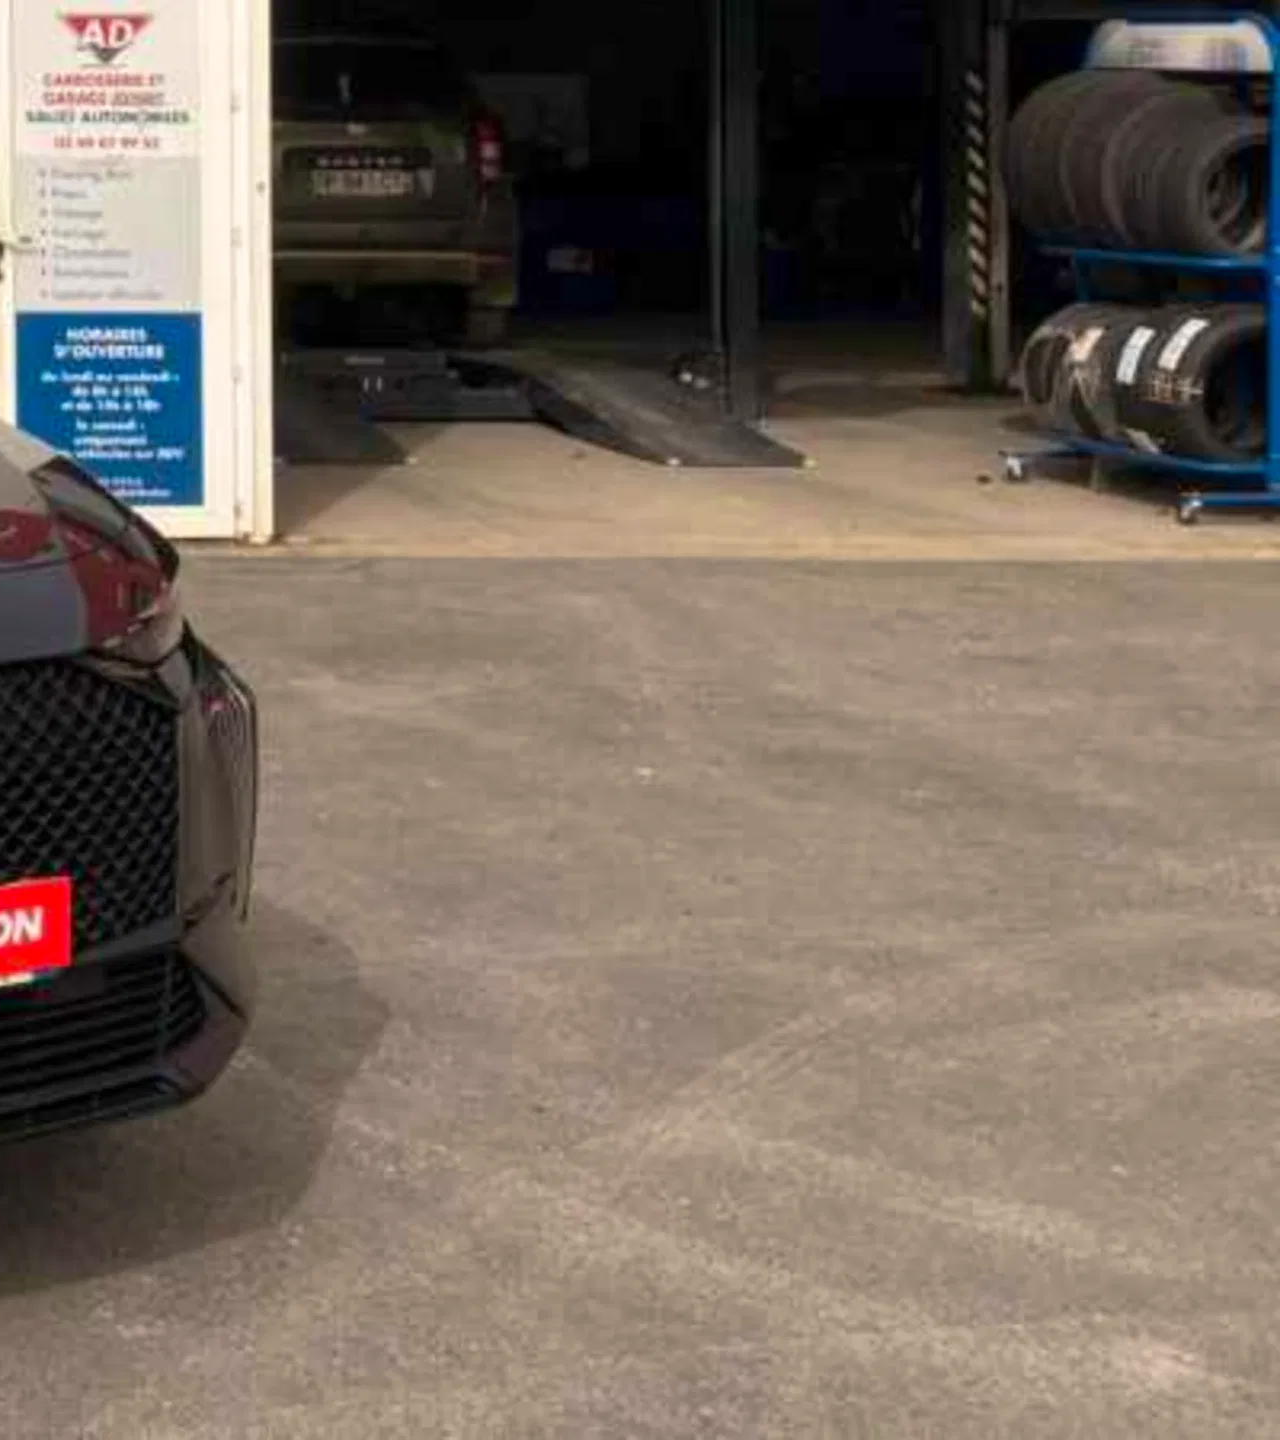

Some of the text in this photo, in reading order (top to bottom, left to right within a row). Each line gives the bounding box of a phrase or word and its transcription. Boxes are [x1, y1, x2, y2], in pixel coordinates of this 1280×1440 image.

[79, 19, 134, 49] AD
[66, 327, 147, 342] HORAIRES
[53, 344, 165, 360] D'OUVERTURE
